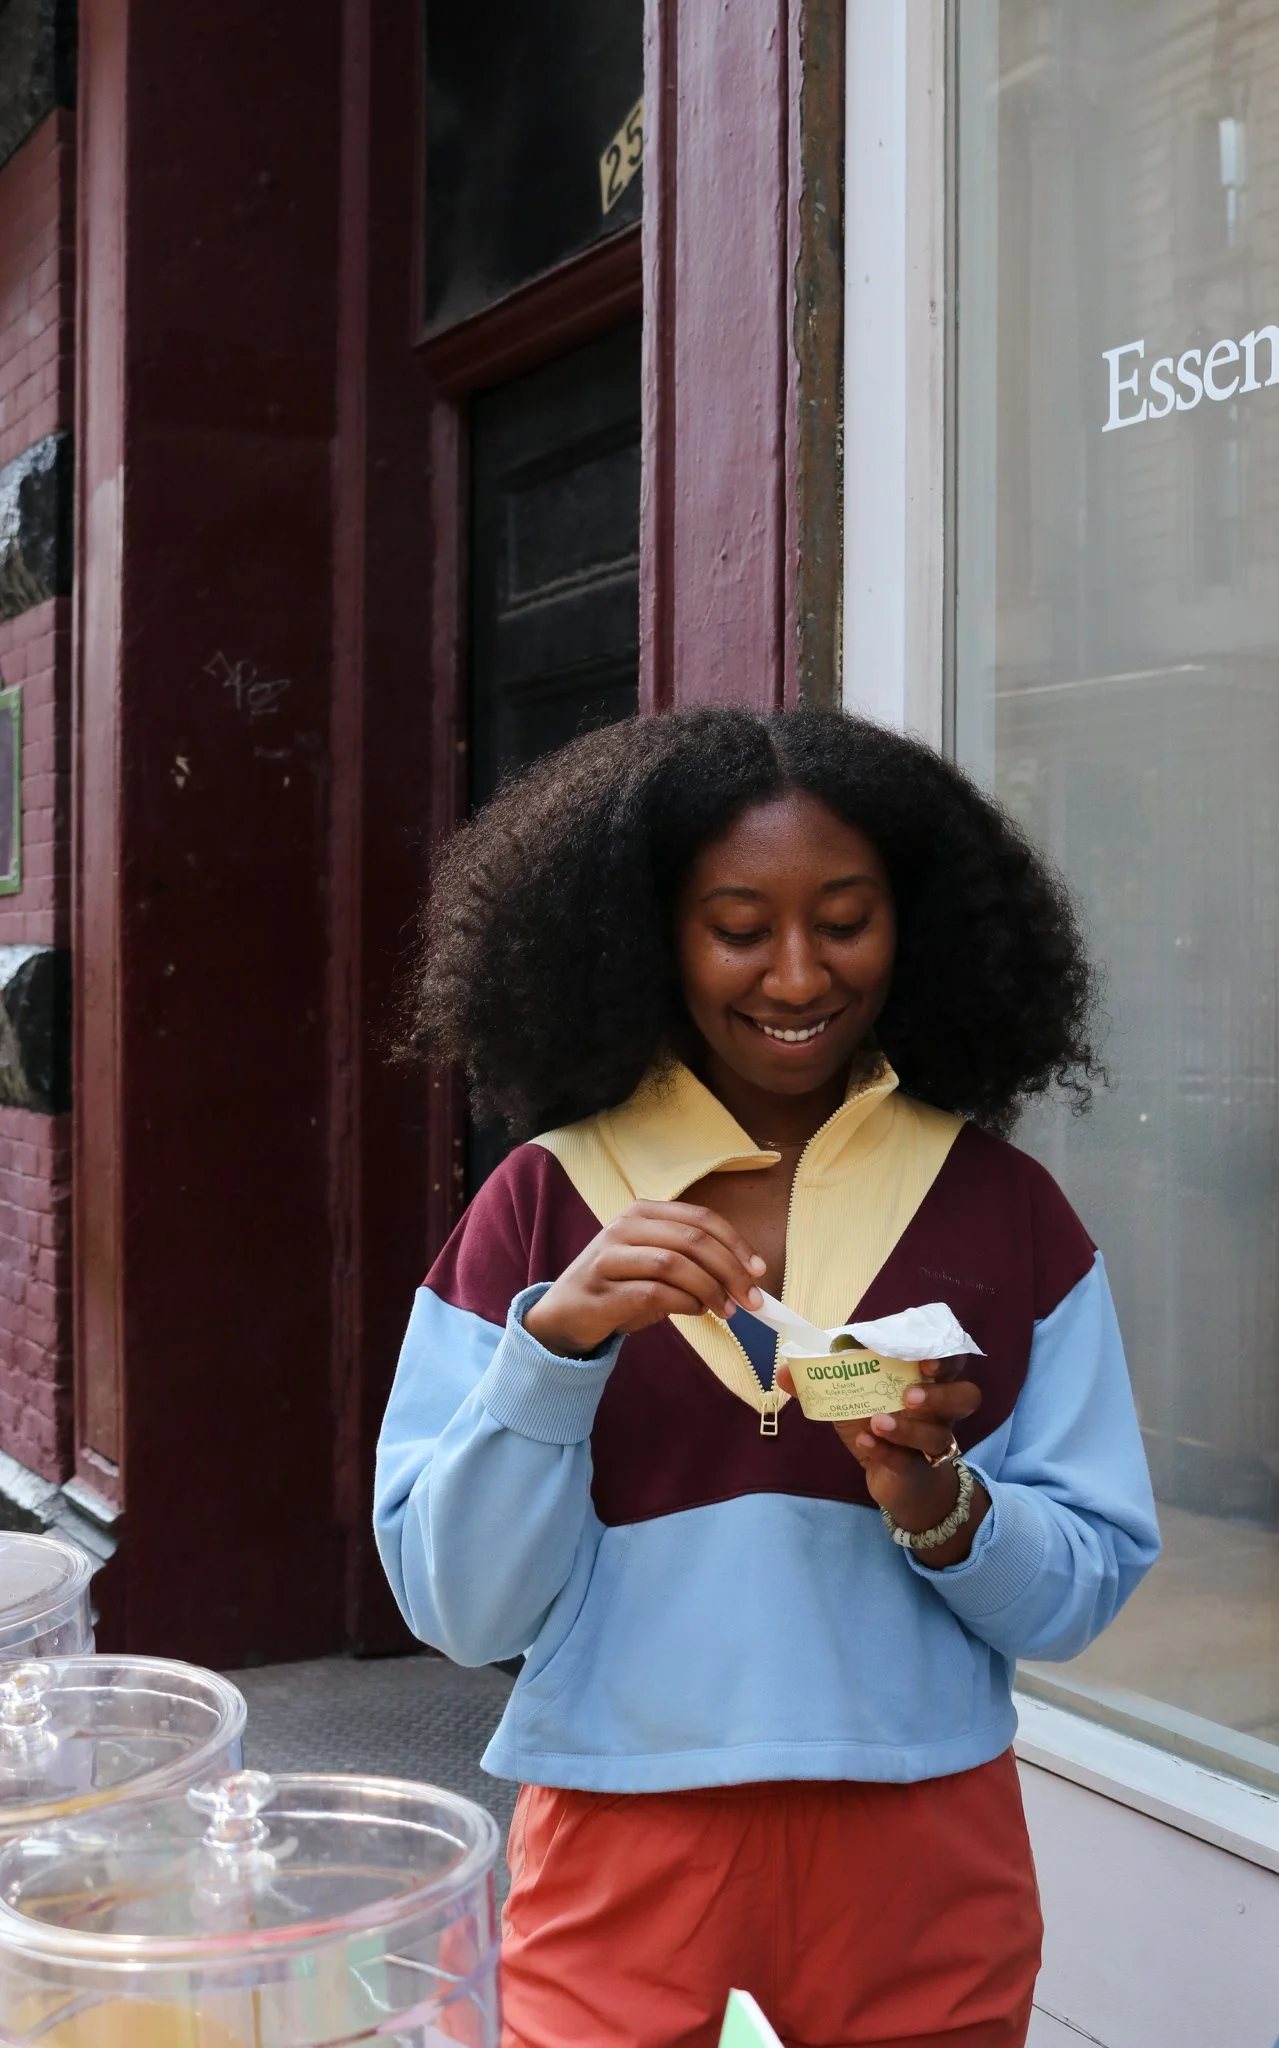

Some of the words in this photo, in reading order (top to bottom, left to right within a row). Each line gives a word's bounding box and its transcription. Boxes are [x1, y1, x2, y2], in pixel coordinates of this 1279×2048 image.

[606, 107, 643, 206] 25
[1101, 324, 1279, 433] Essen
[806, 1358, 881, 1381] cocojune
[819, 1410, 850, 1418] CULTURED
[851, 1405, 887, 1417] COCONUT
[829, 1401, 871, 1412] ORGANIC
